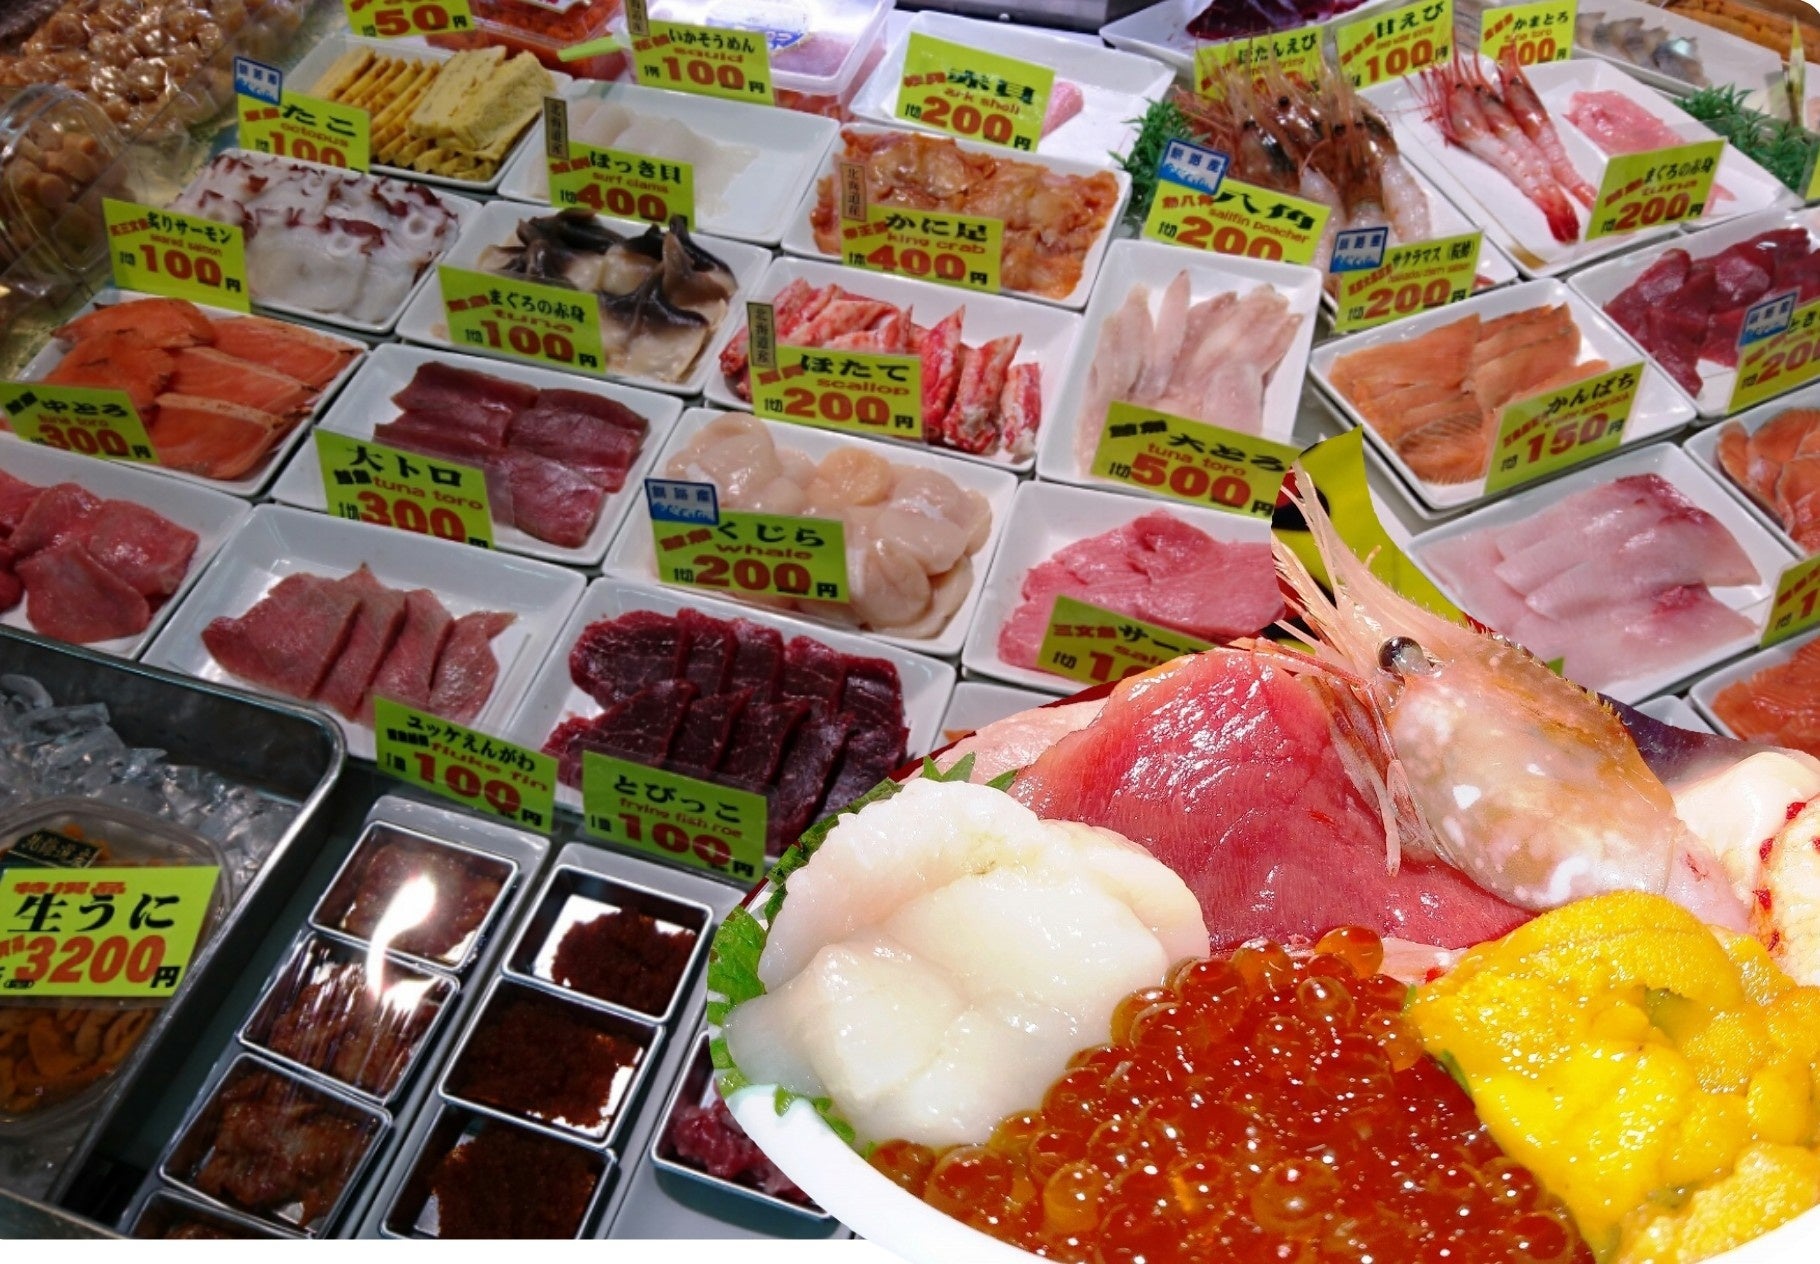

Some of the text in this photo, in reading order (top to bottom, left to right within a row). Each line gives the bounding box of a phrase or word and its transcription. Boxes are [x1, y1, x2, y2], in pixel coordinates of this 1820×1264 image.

[669, 28, 755, 54] いかそうめん
[282, 104, 357, 137] たこ
[590, 150, 682, 184] ほっき貝
[1645, 157, 1714, 184] まぐろの赤身
[147, 211, 232, 244] 炙りサーモン
[886, 214, 988, 242] かに足
[887, 233, 986, 255] king crab
[1252, 220, 1312, 244] poacher
[489, 289, 585, 323] まぐろの赤身
[801, 354, 910, 382] ほたて
[817, 378, 910, 396] scallop
[345, 445, 462, 487] 大トロ
[1147, 442, 1247, 477] tuna toro
[1168, 433, 1285, 473] 大とろ
[371, 476, 426, 498] tuna
[433, 490, 484, 511] toro
[717, 521, 825, 547] くじら
[716, 543, 813, 561] whale
[1118, 624, 1206, 655] サー
[406, 714, 536, 773] ユッケえんがわ
[431, 742, 548, 792] fluke fin
[613, 774, 741, 823] とびっこ
[675, 812, 708, 829] fish
[713, 823, 744, 840] roe
[7, 893, 180, 932] 生うに
